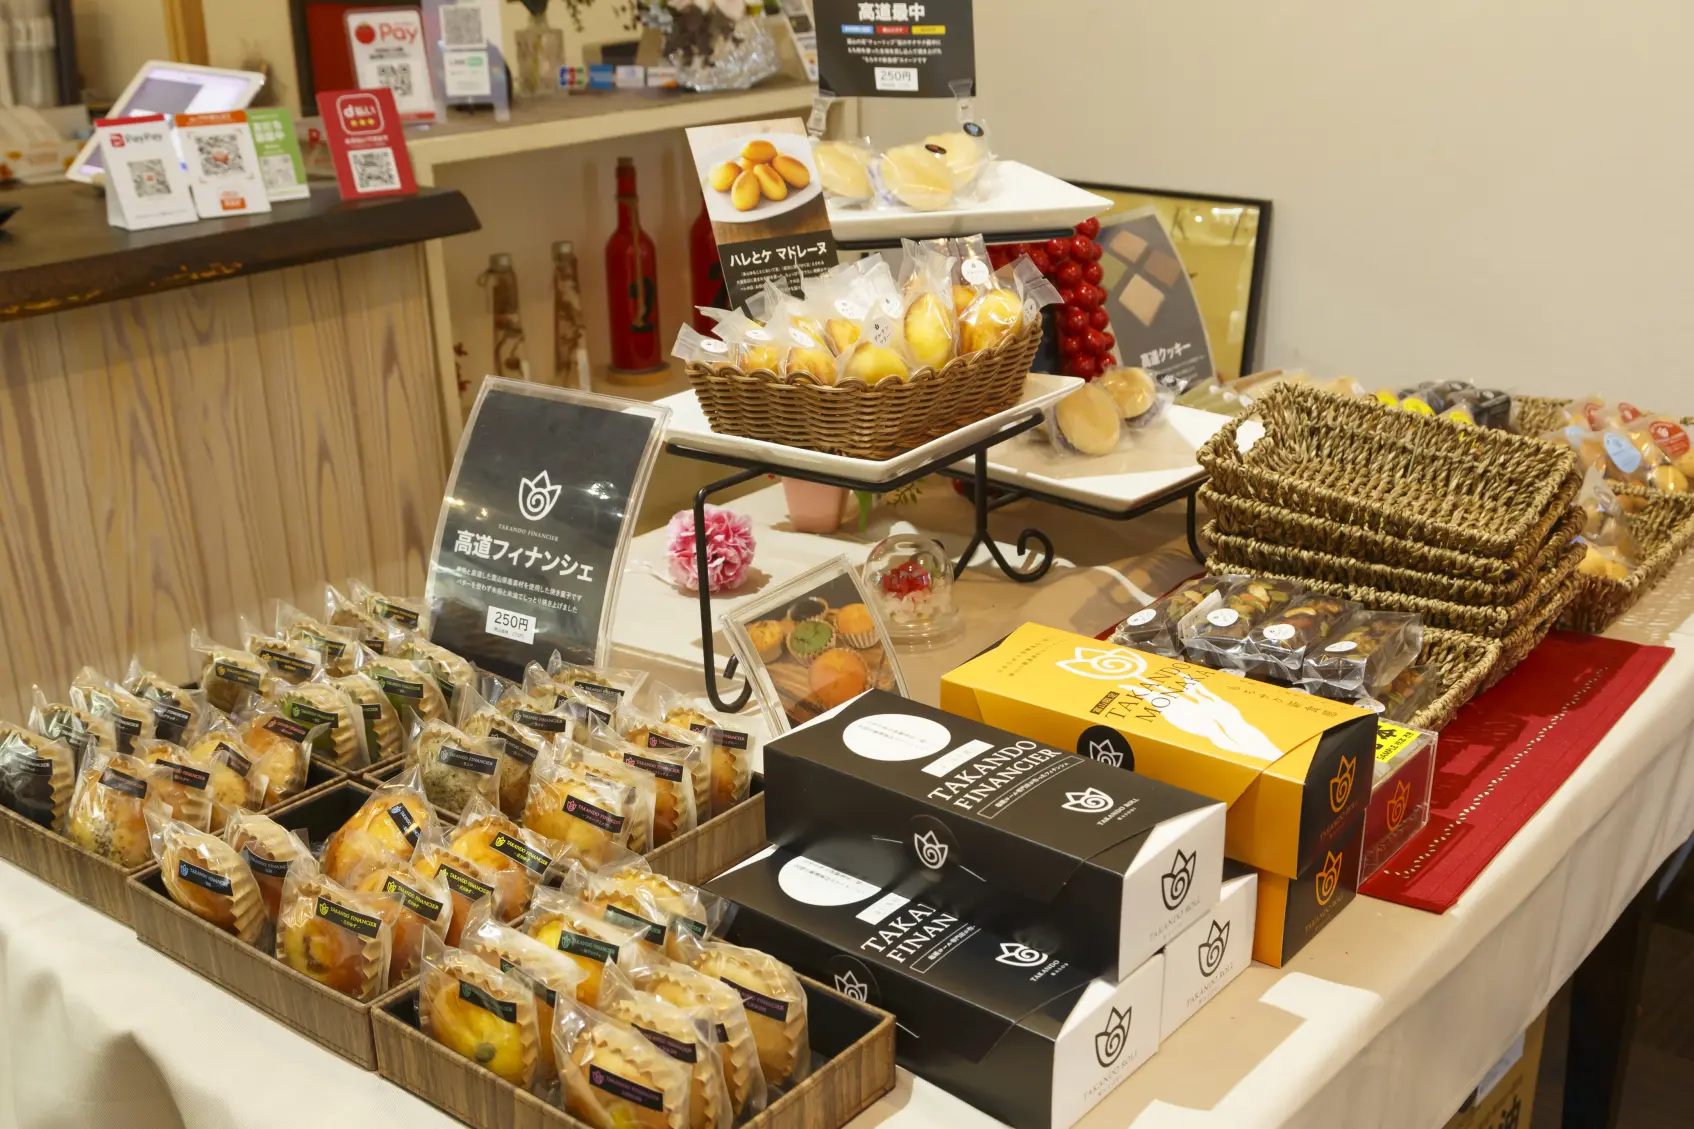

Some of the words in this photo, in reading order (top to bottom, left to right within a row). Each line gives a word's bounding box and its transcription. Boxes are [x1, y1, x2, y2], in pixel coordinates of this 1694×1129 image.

[857, 2, 926, 22] 高道最中
[379, 21, 419, 45] Pay
[880, 70, 912, 82] 250円
[126, 131, 163, 145] PayPay
[730, 249, 772, 268] ハレとケ
[775, 241, 828, 261] マドレーヌ
[498, 523, 526, 535] TAKANDO
[528, 529, 559, 543] FINANCIER
[453, 529, 595, 583] 高道フィナンシェ
[494, 611, 529, 632] 250円
[1104, 662, 1191, 719] TAKANDO
[1135, 669, 1216, 723] MONAKA
[448, 751, 469, 762] TAKANDO
[468, 755, 494, 767] FINANCIER
[635, 759, 657, 769] TAKANDO
[927, 740, 1037, 802] TAKANDO
[953, 747, 1063, 811] FINANCIER
[578, 803, 599, 818] TAKANDO
[600, 812, 622, 825] FINANCIER
[506, 839, 526, 853] TAKANDO
[526, 849, 549, 867] FINANCIER
[449, 870, 468, 885] TAKANDO
[397, 885, 415, 899] TAKANDO
[414, 893, 440, 911] FINANCIER
[330, 907, 350, 920] TAKANDO
[350, 915, 377, 929] FINANCIER
[1029, 959, 1061, 983] TAKANDO
